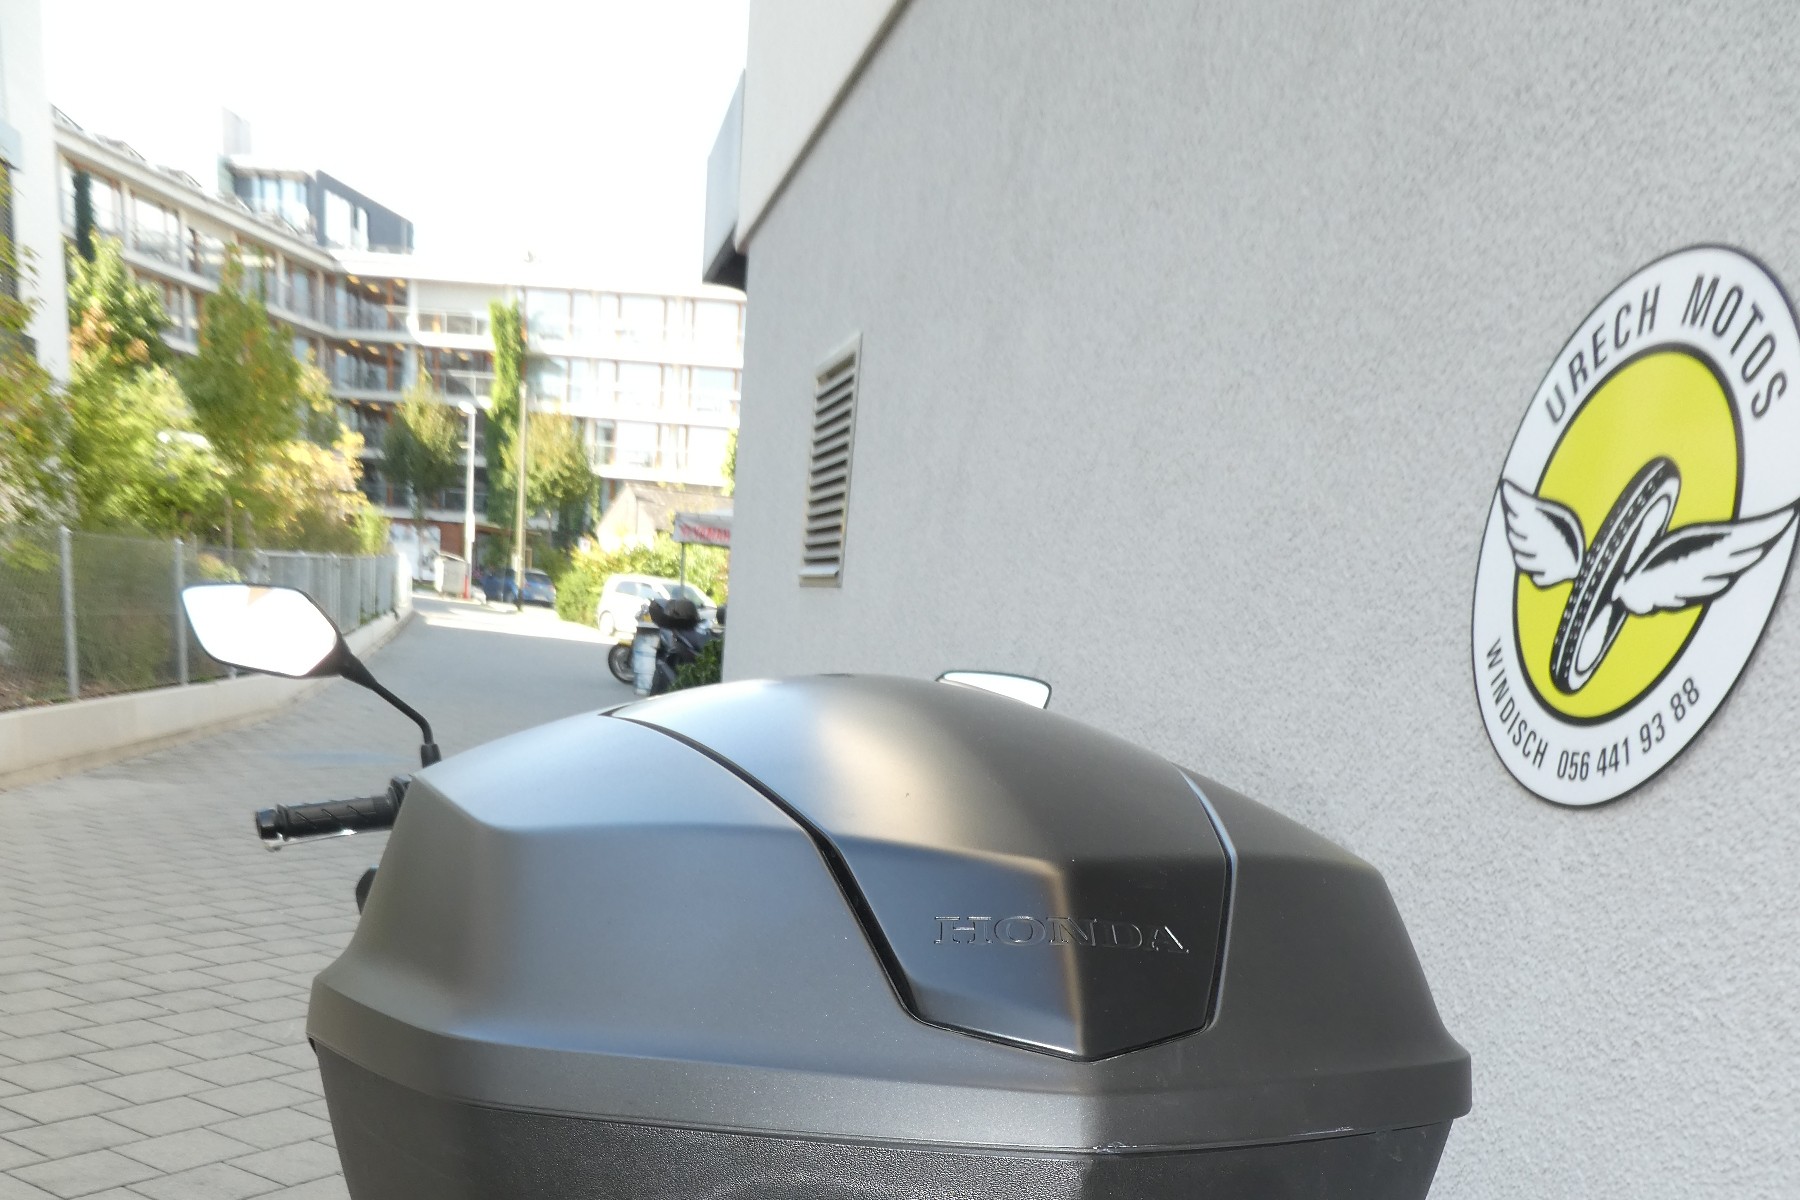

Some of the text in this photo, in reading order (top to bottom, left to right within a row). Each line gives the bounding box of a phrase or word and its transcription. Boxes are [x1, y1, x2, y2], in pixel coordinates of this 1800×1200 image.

[1545, 273, 1788, 424] URECH MOTOS
[1486, 637, 1700, 782] WINDISCH 056 441 93 88
[933, 915, 1190, 954] HONDA
